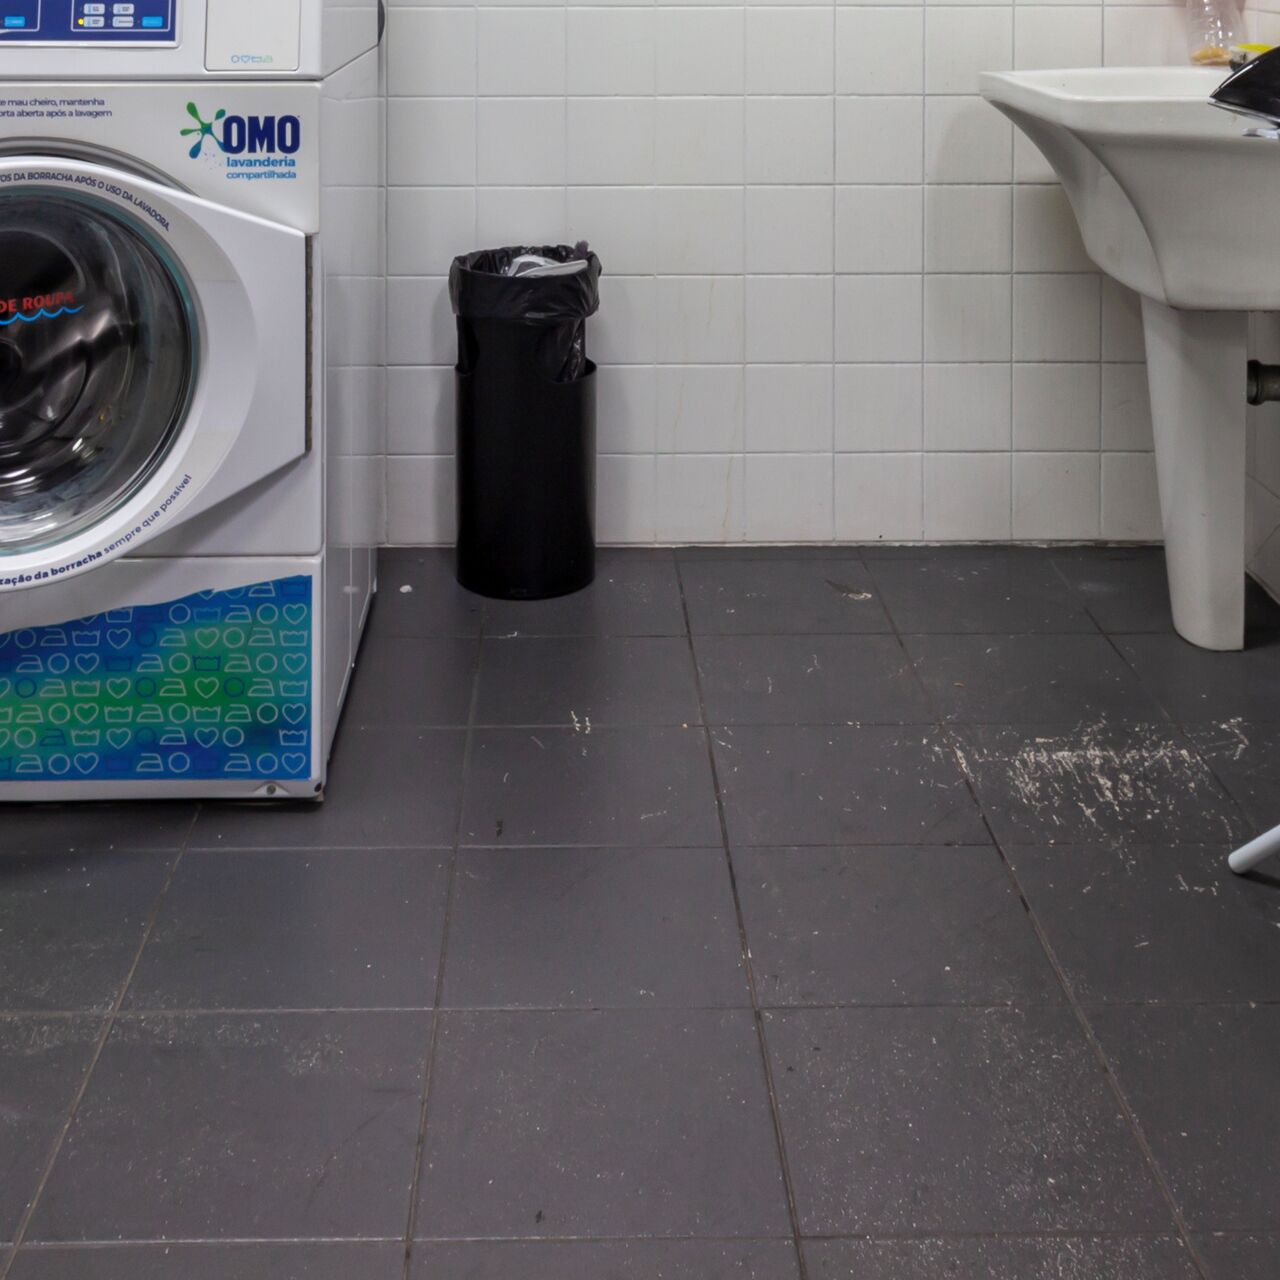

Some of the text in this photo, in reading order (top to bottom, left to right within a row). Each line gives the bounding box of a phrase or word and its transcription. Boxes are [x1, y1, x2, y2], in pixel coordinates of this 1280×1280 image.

[7, 99, 28, 107] mau
[29, 97, 58, 109] cheiro,
[59, 97, 104, 107] mantenha
[16, 108, 44, 118] aberta
[46, 108, 67, 120] após
[68, 110, 73, 118] a
[75, 108, 111, 120] lavagem
[223, 115, 299, 154] OMO
[226, 156, 296, 168] lavanderia
[226, 170, 297, 181] compartilhada
[14, 173, 26, 181] DA
[28, 172, 73, 182] BORRACHA
[74, 175, 96, 187] APÓS
[98, 181, 104, 189] O
[106, 184, 121, 196] USO
[122, 191, 132, 202] DA
[134, 198, 170, 232] LAVADORA
[23, 290, 74, 310] ROUPA
[34, 571, 49, 580] da
[51, 551, 103, 576] borracha
[104, 526, 142, 554] sempre
[142, 511, 160, 528] que
[160, 474, 192, 512] possível
